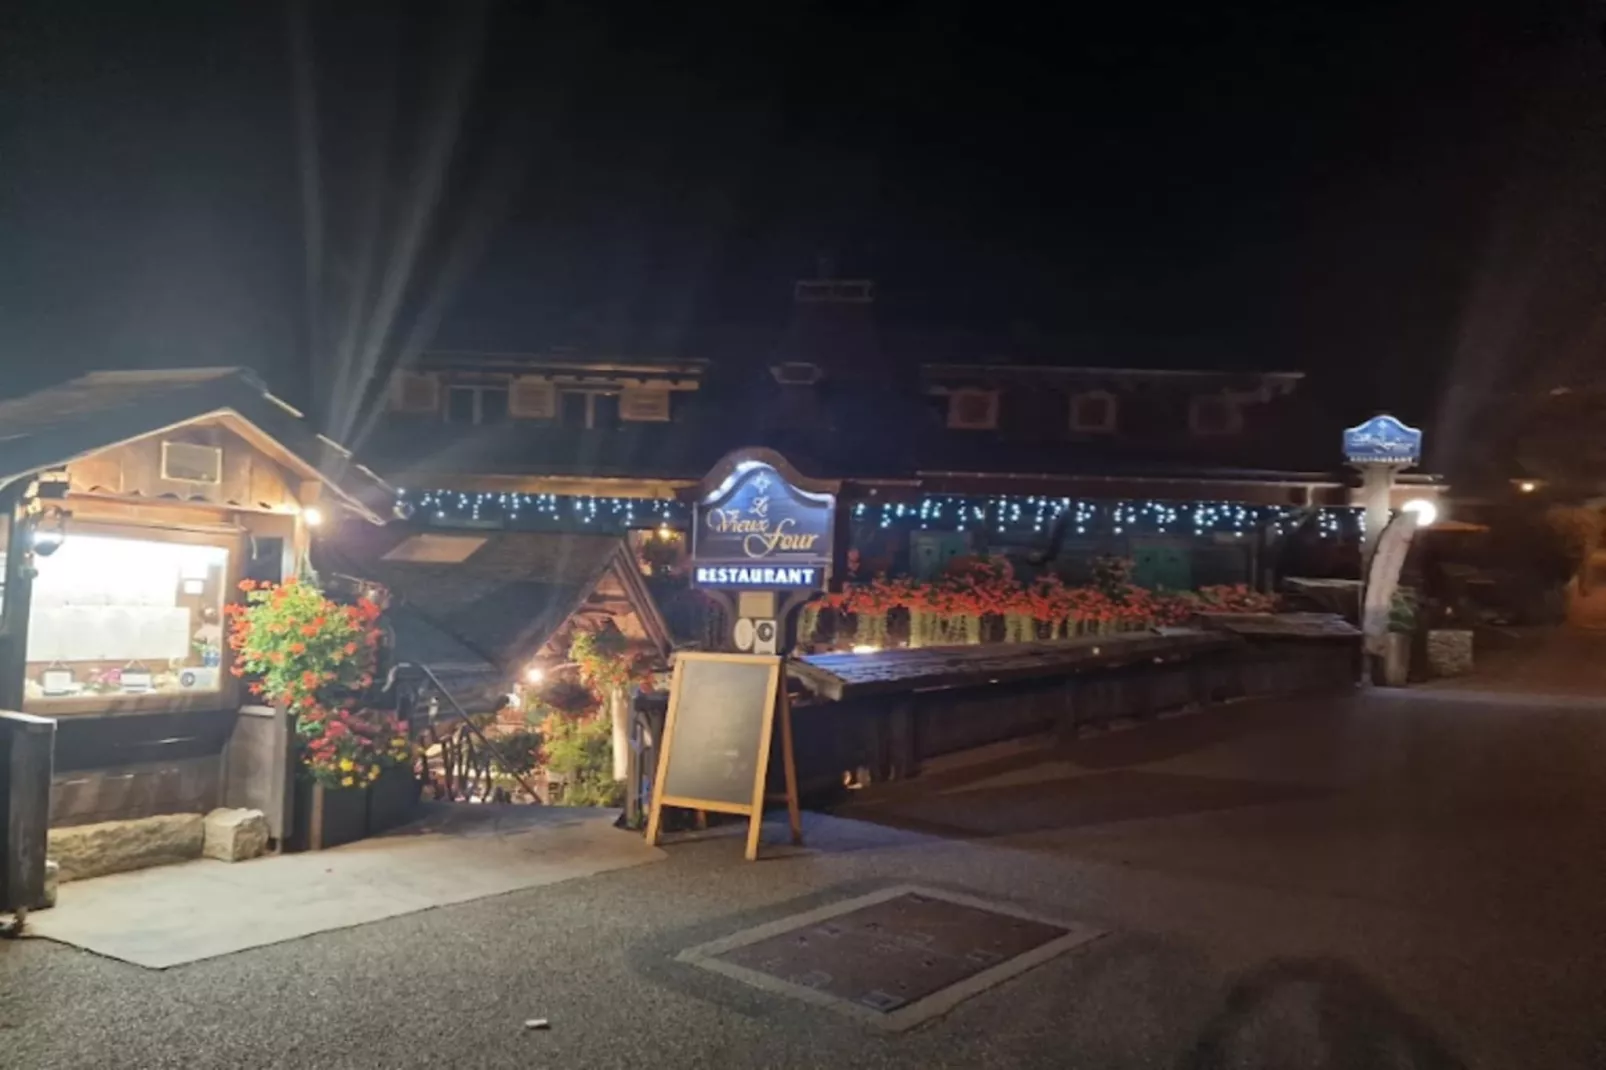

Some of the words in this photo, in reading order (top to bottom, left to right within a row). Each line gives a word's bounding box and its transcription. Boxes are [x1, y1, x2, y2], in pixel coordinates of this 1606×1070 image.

[749, 496, 770, 517] Le
[706, 508, 770, 533] Vieux
[696, 568, 815, 584] RESTAURANT
